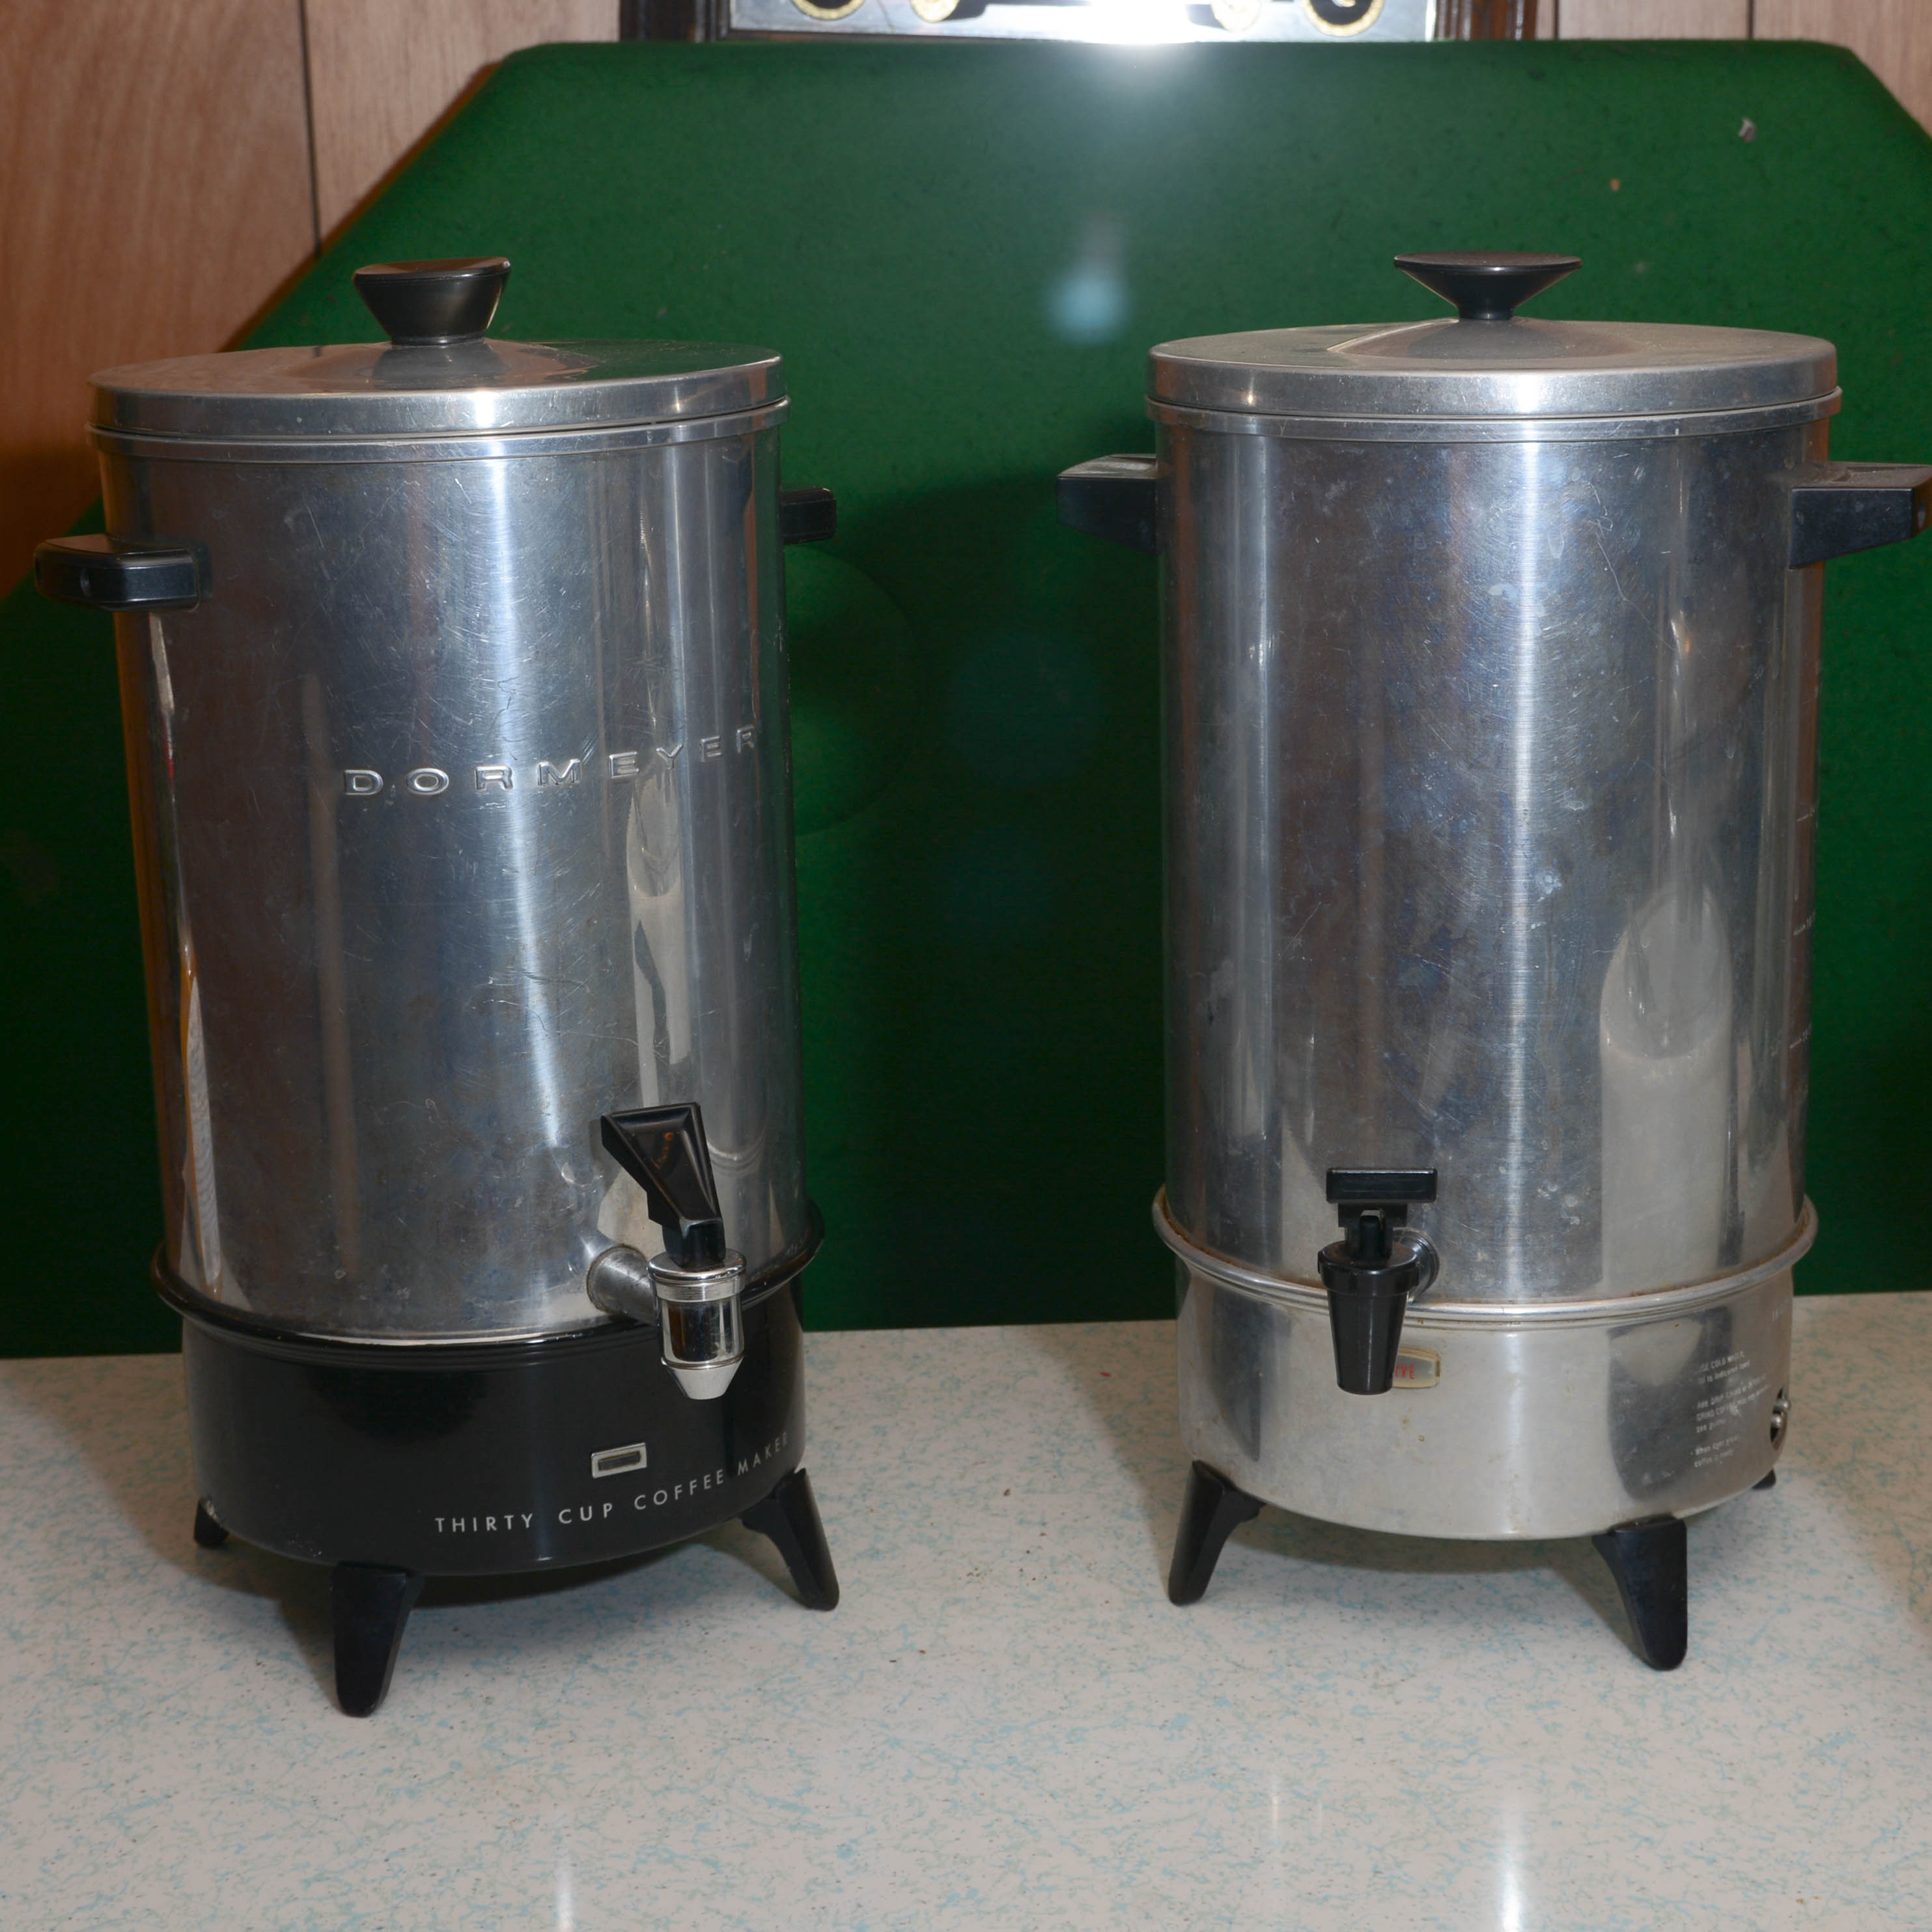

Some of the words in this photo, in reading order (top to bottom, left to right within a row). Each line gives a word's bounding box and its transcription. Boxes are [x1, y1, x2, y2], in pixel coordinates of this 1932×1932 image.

[343, 723, 756, 796] DORMEYER
[434, 1513, 533, 1533] THIRTY
[558, 1502, 613, 1525] CUP
[634, 1468, 724, 1511] COFFEE
